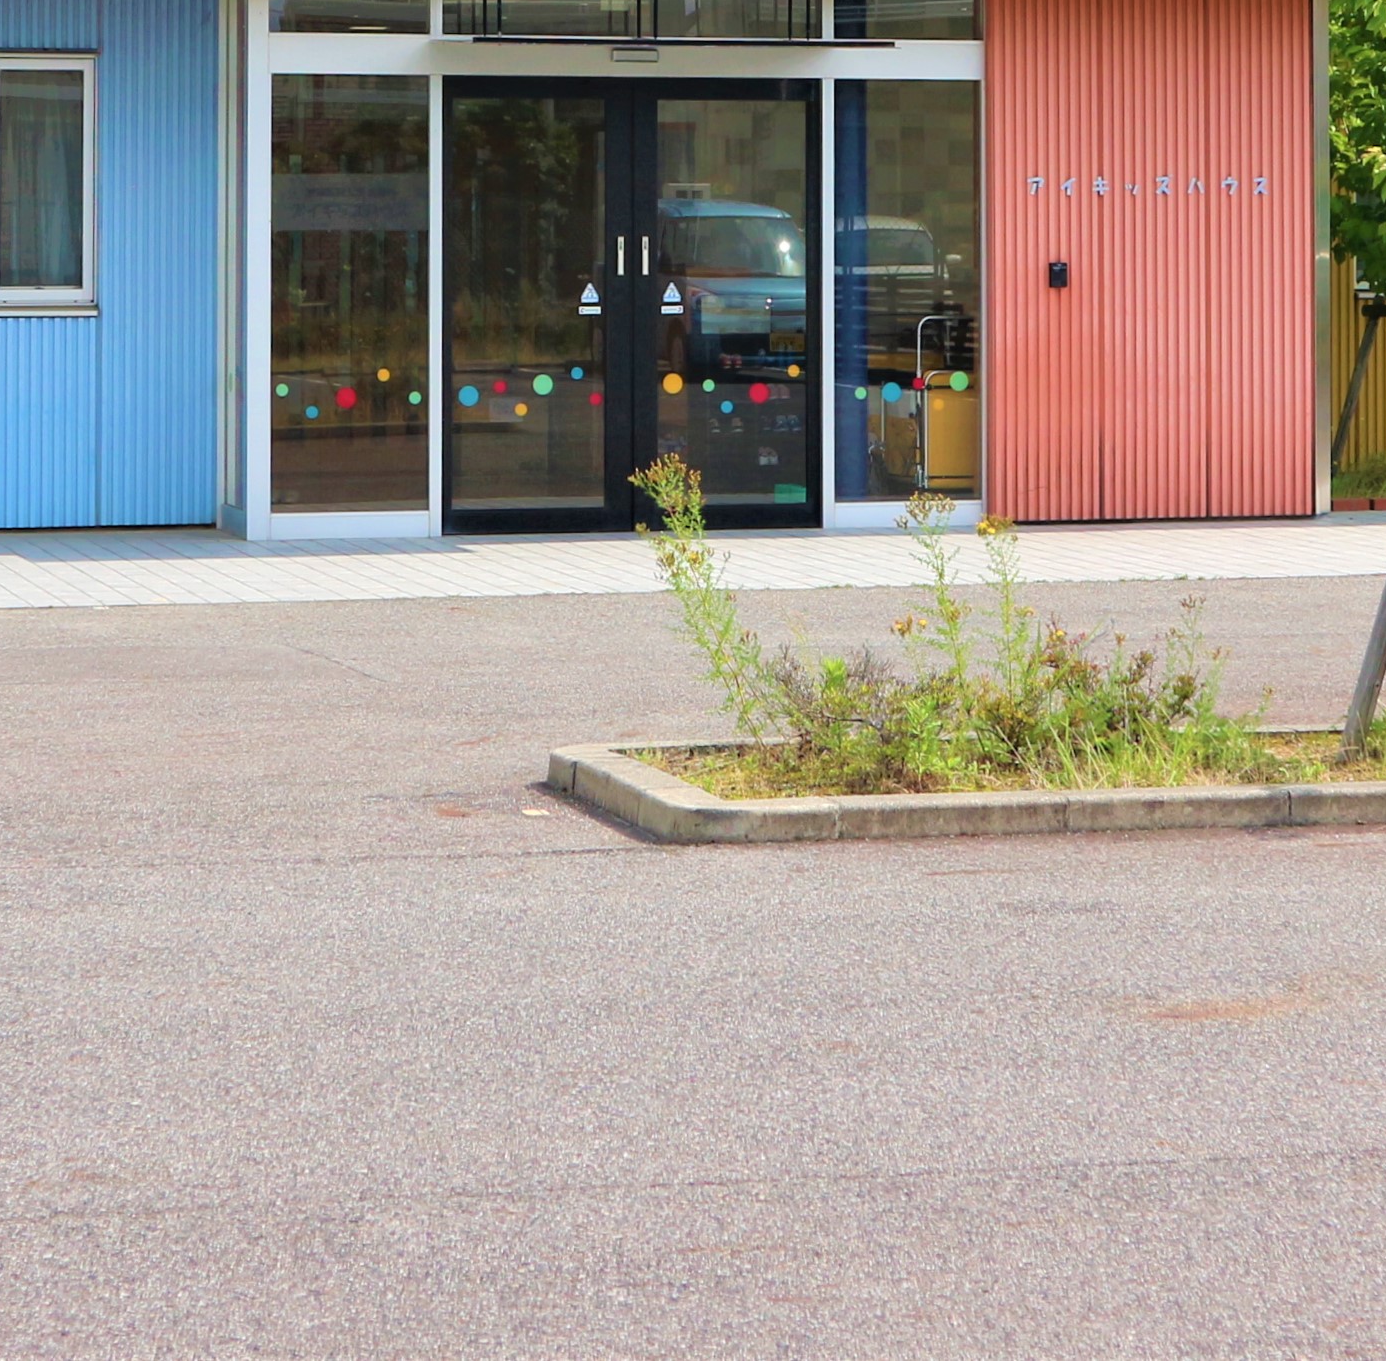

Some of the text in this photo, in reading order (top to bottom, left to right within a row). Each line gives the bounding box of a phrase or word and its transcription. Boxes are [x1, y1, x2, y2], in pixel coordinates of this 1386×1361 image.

[1027, 174, 1269, 196] アイキッズハウス
